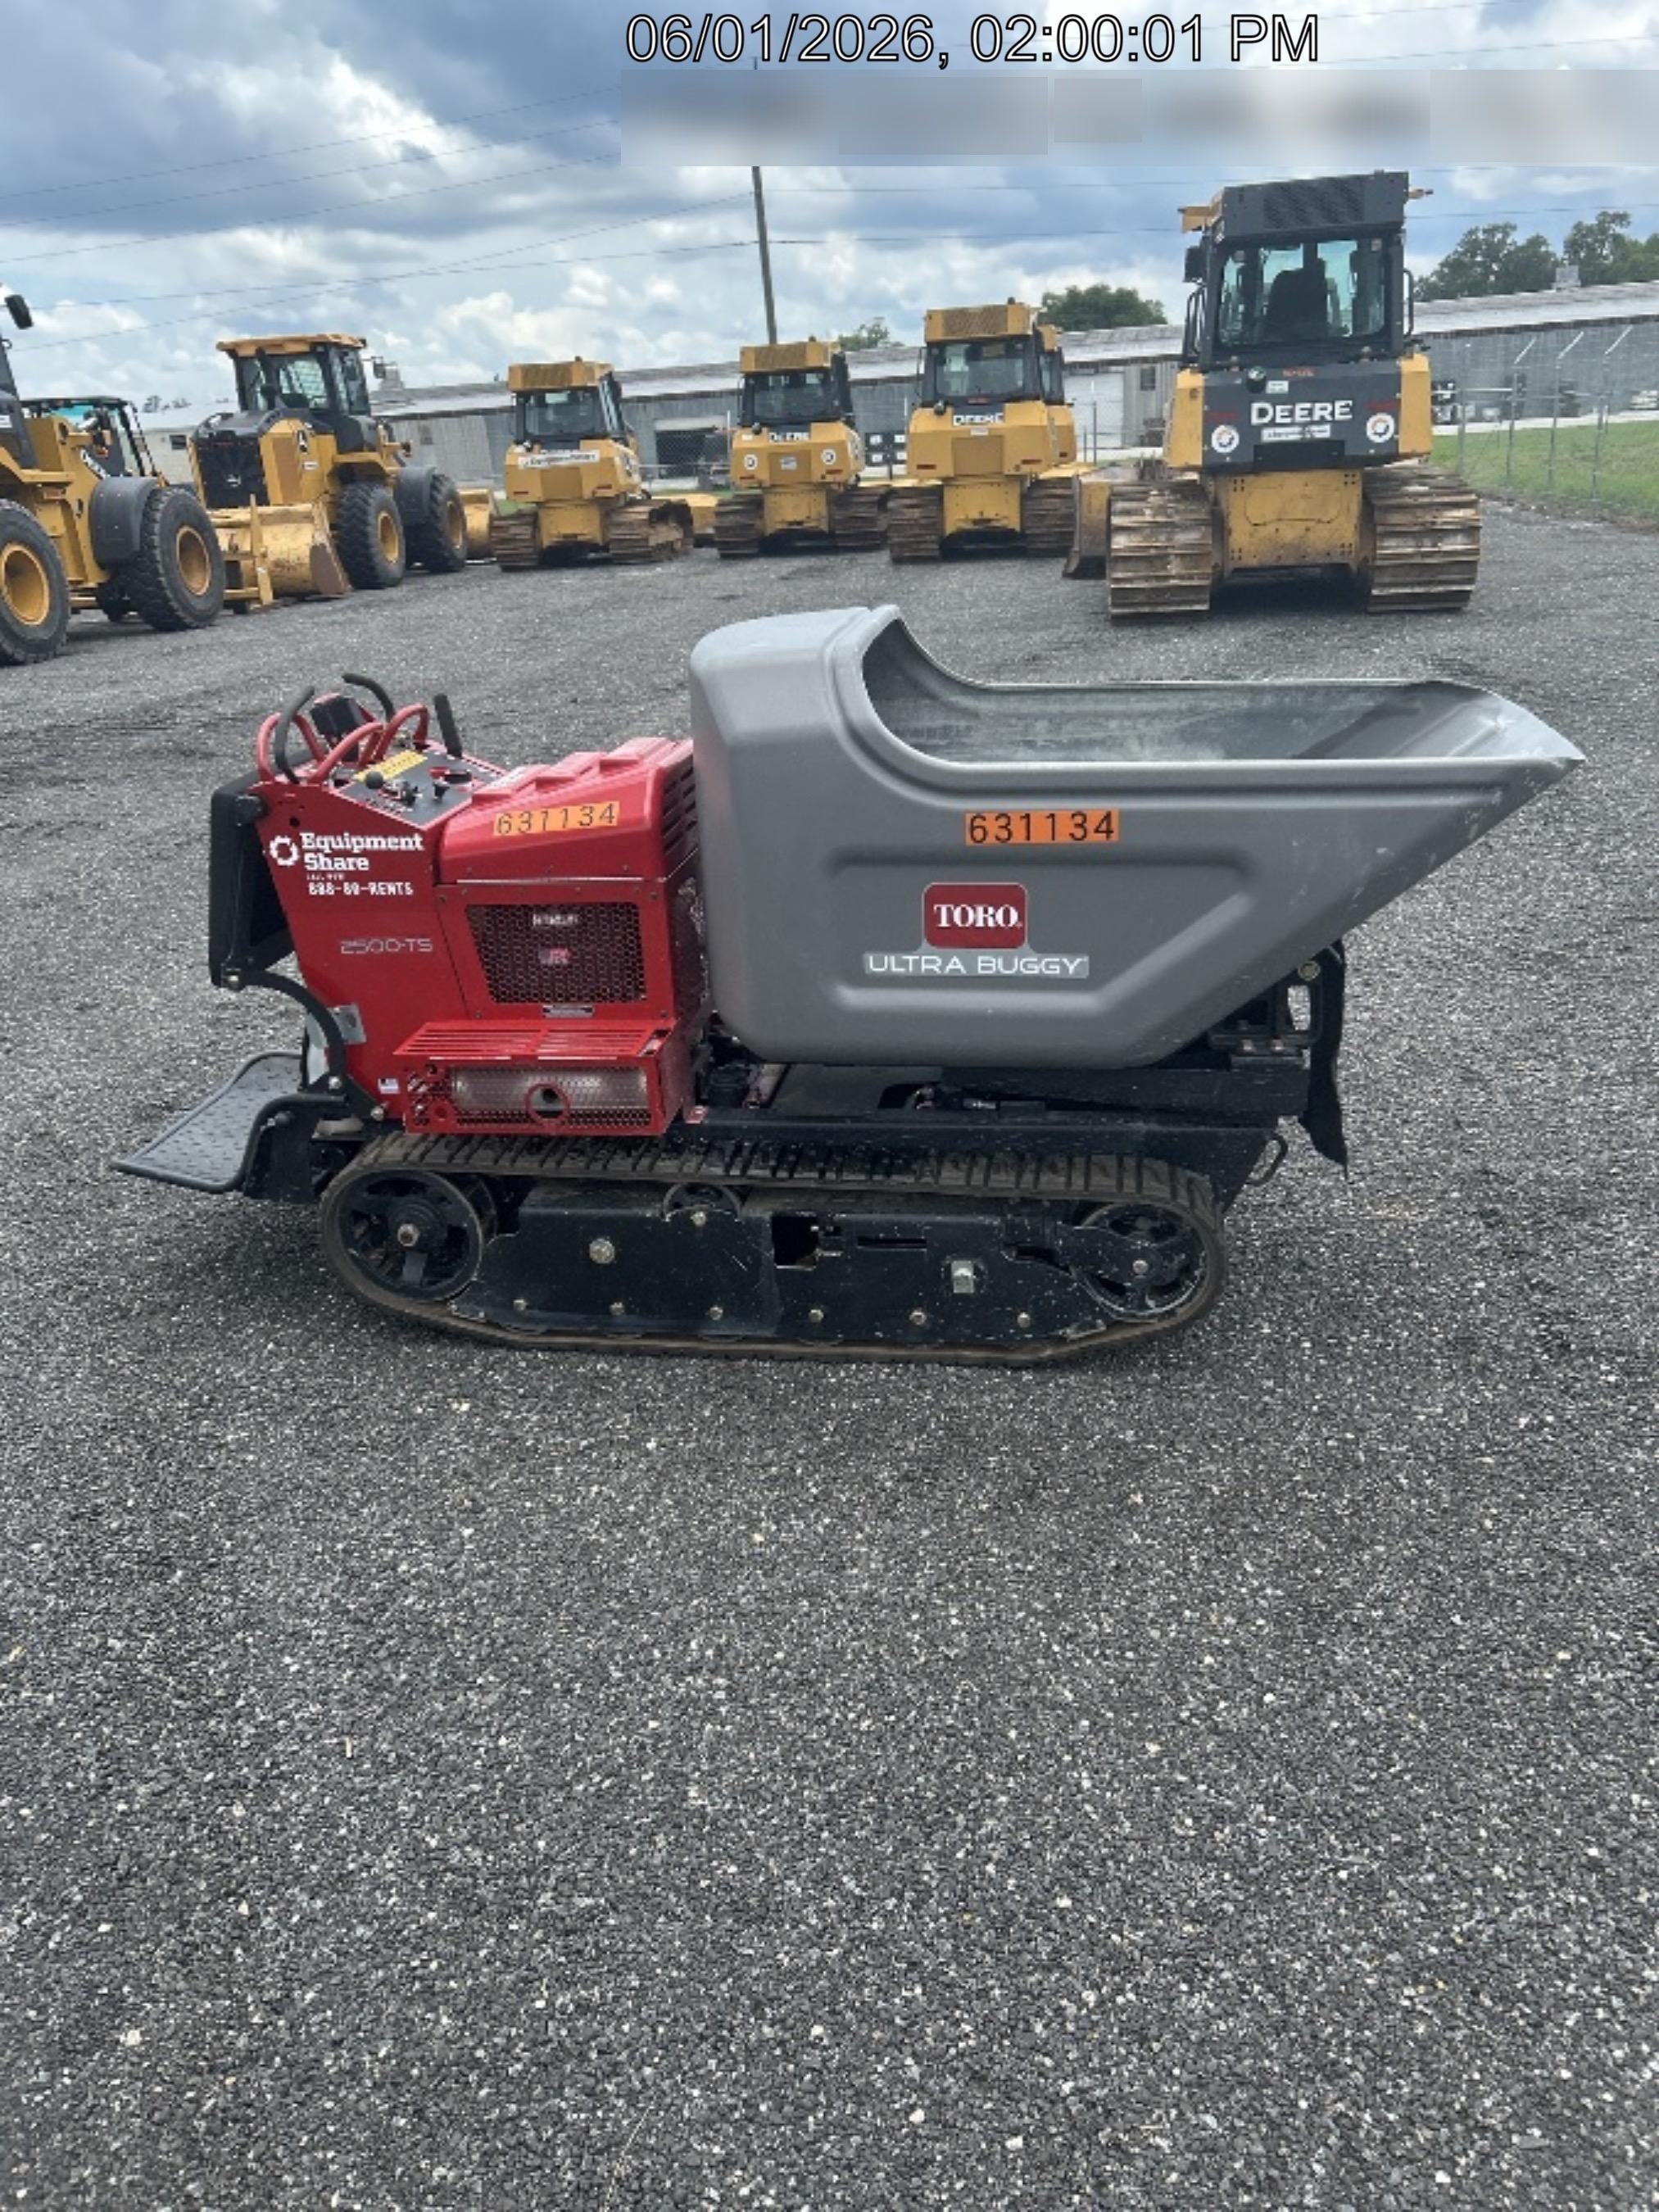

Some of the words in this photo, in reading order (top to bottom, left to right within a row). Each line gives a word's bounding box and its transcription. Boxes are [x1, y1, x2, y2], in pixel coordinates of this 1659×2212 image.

[1250, 399, 1353, 426] DEERE
[496, 802, 615, 834] 631134
[969, 810, 1115, 844] 631134
[299, 832, 425, 854] Equipment
[303, 852, 369, 871] Share
[934, 904, 1019, 928] TORO
[340, 937, 433, 955] 2500-TS
[868, 955, 967, 974] ULTRA
[977, 955, 1081, 975] BUGGY
